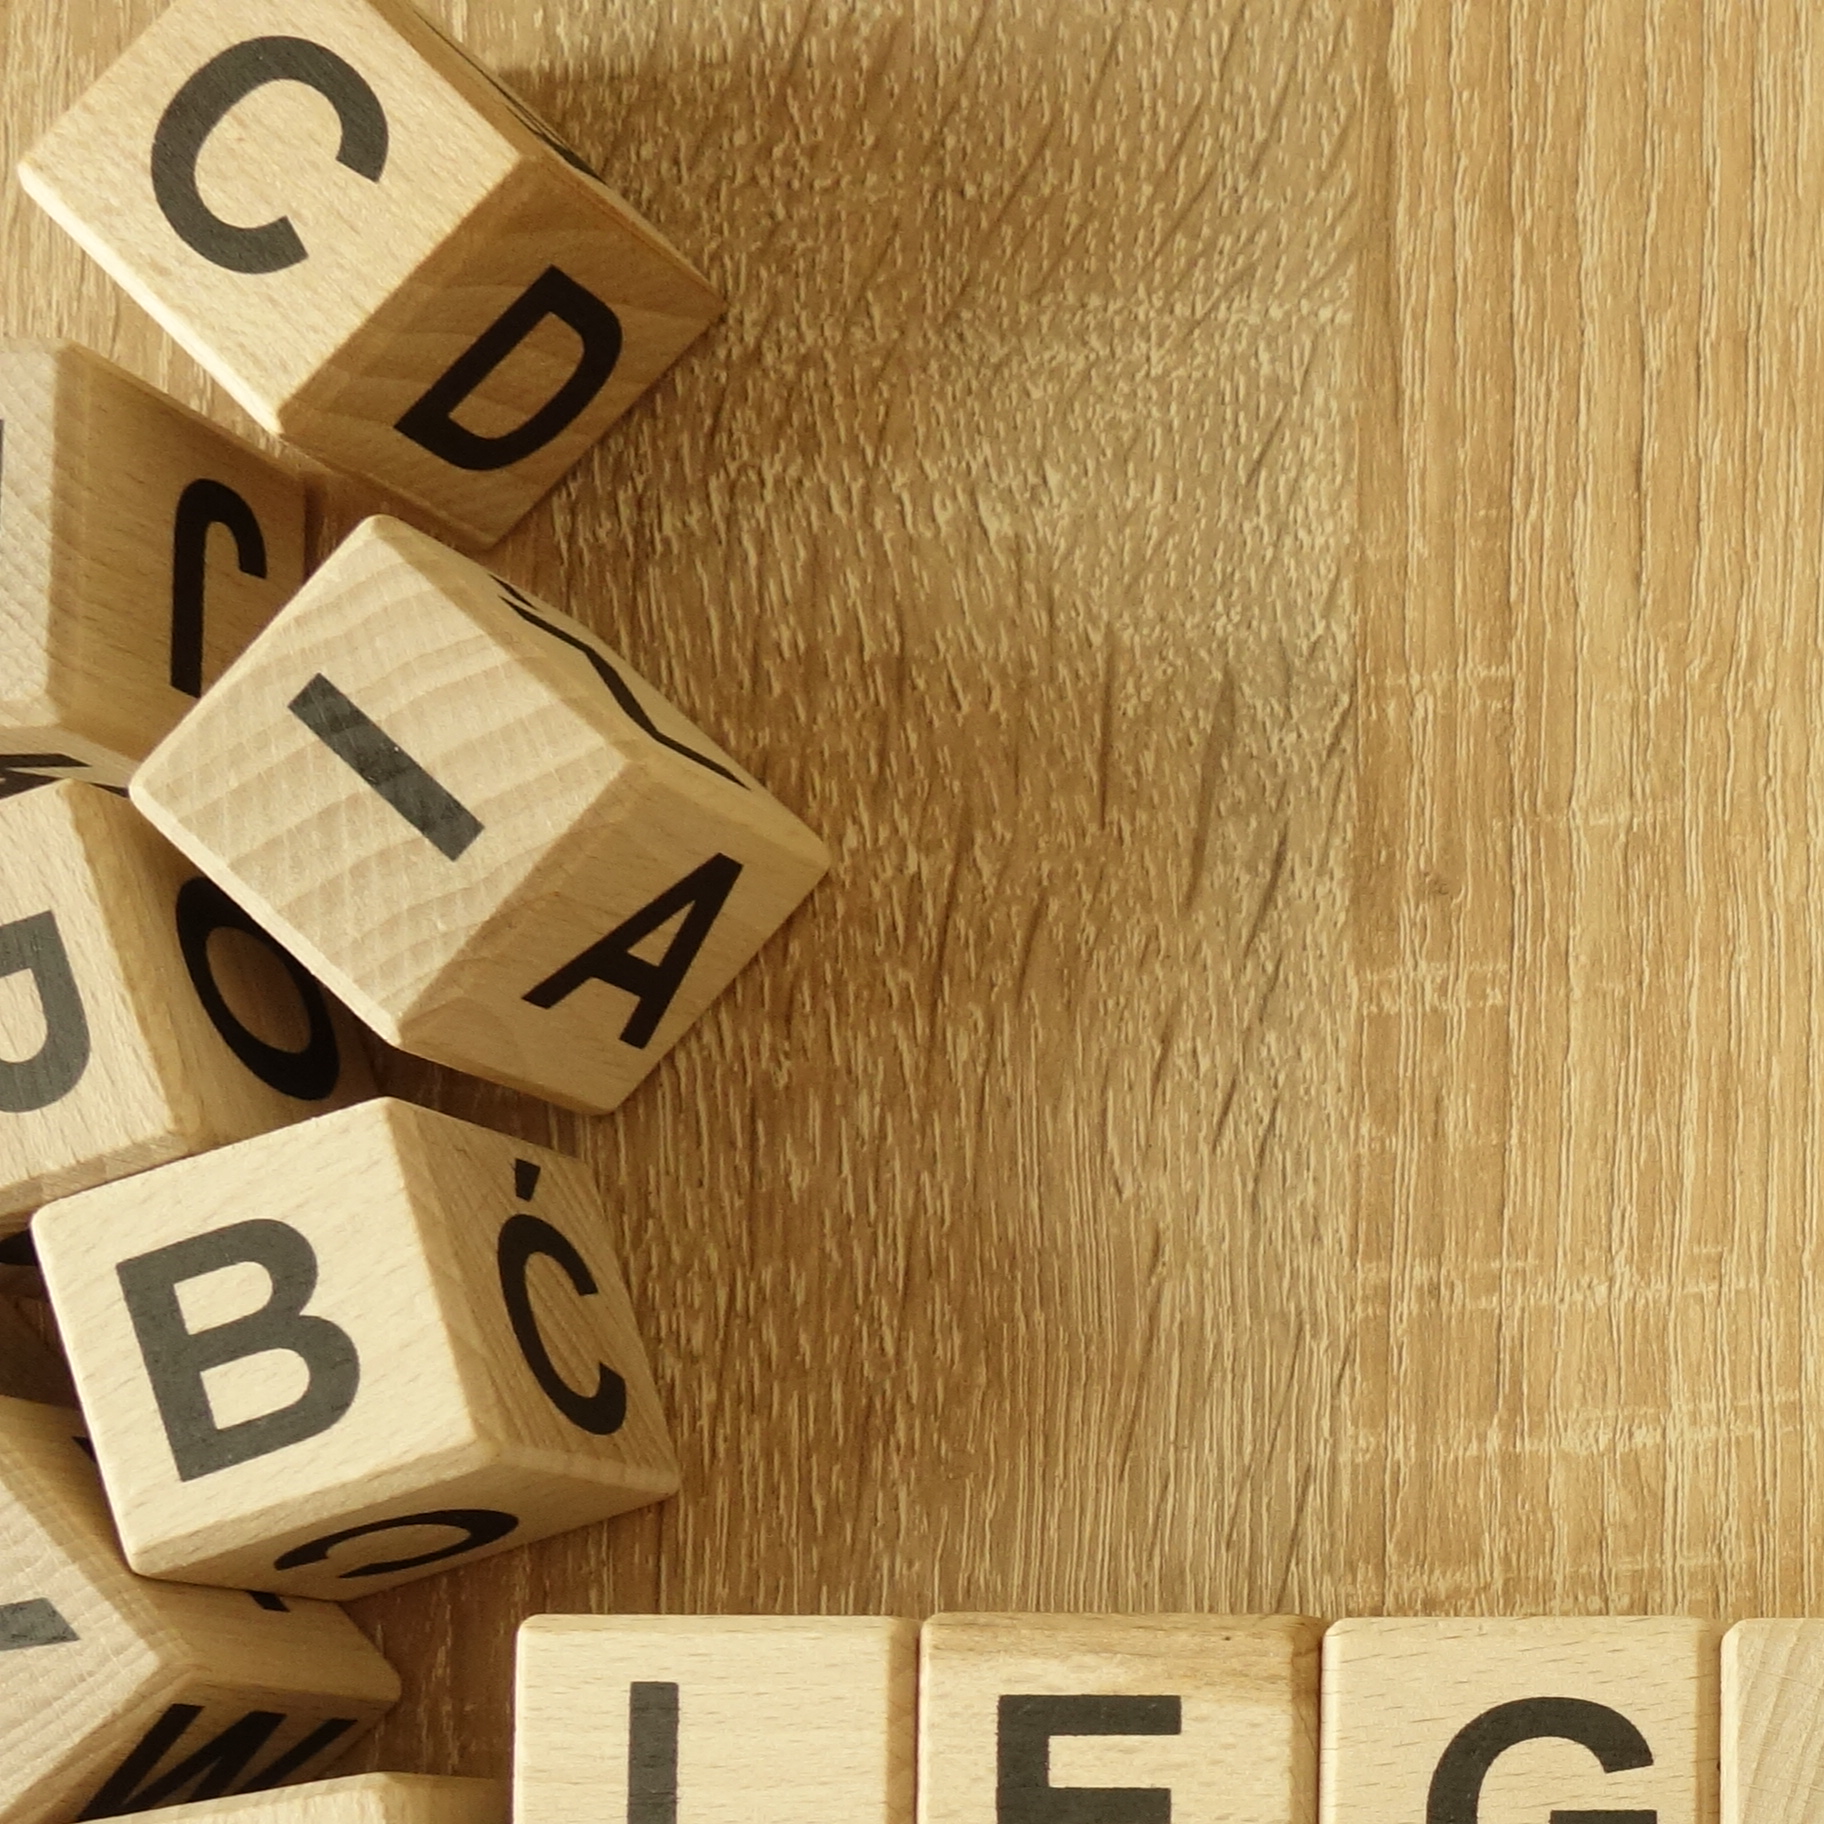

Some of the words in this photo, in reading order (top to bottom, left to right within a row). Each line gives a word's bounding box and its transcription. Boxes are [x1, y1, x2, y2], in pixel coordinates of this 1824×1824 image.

[151, 35, 388, 274] C
[393, 264, 623, 471] D
[287, 673, 485, 862] I
[522, 852, 743, 1050] A
[116, 1218, 360, 1482] B
